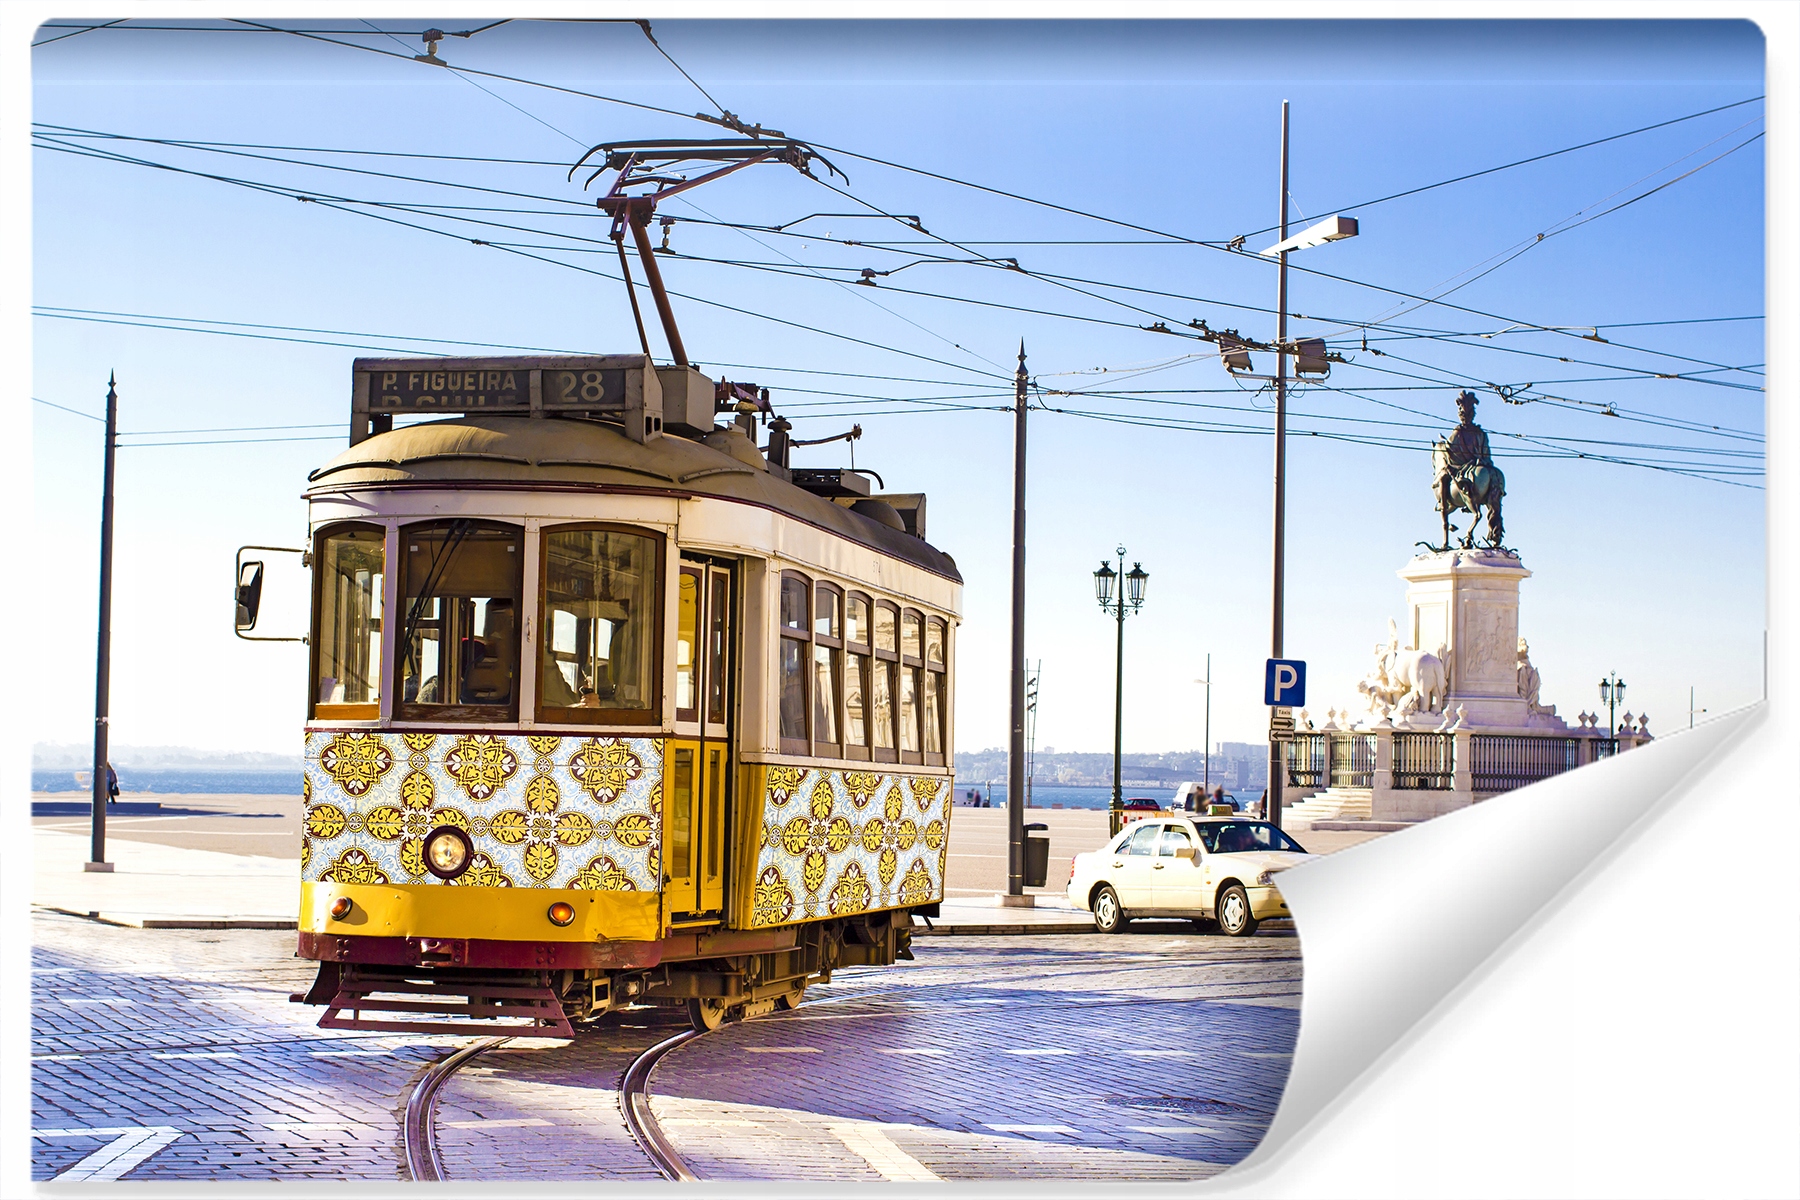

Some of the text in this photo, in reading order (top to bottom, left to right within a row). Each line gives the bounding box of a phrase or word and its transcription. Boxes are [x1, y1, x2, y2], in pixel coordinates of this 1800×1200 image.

[382, 371, 517, 391] P. FIGUEIRA
[557, 370, 605, 402] 28
[1274, 664, 1297, 701] P
